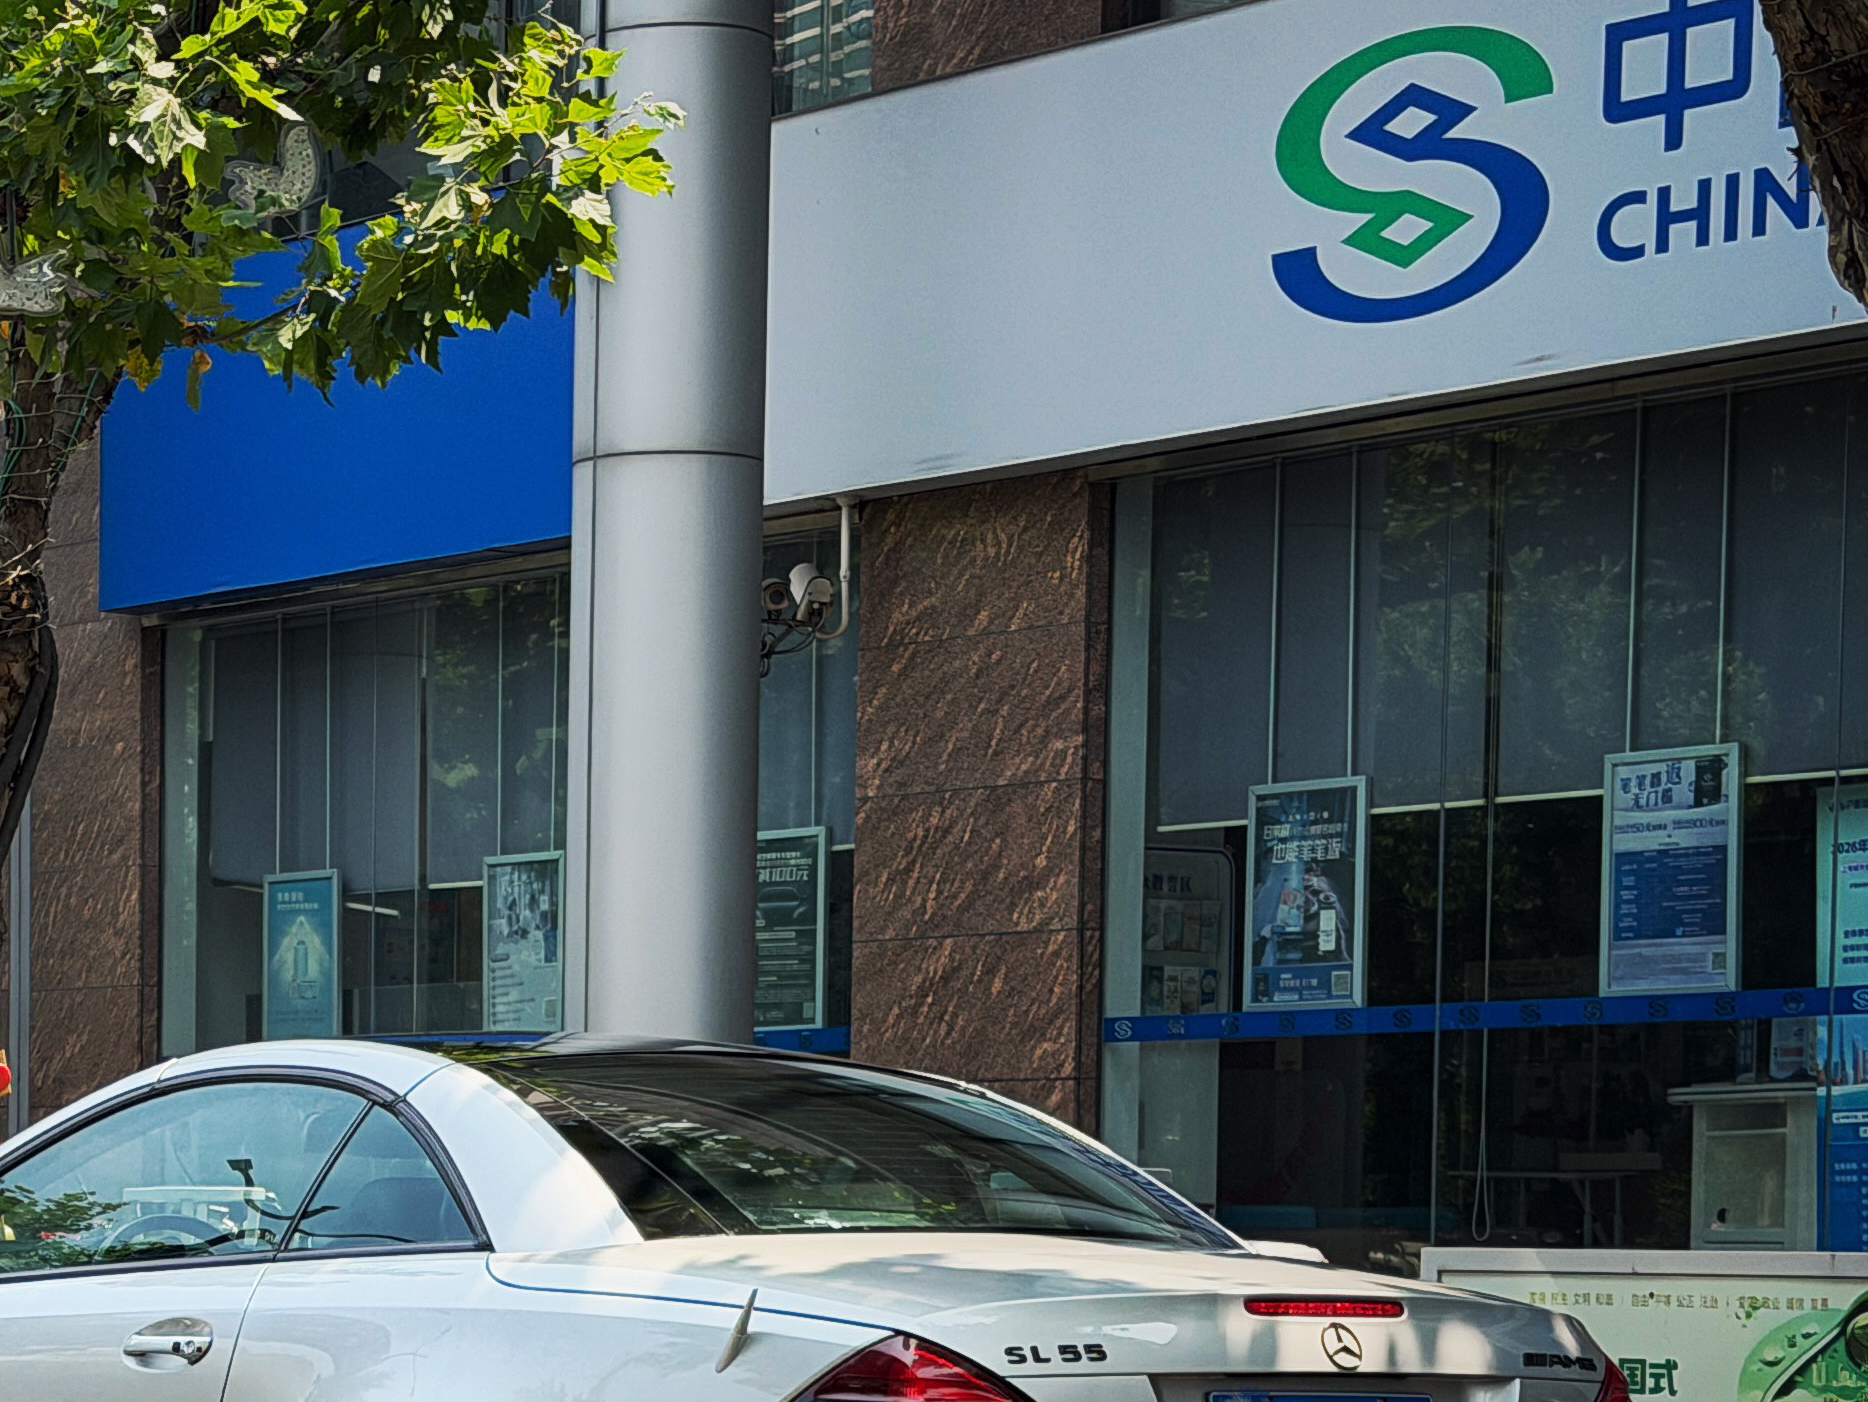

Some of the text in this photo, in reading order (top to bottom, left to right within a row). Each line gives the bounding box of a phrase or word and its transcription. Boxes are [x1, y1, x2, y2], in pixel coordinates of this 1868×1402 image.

[1596, 166, 1826, 262] CHIN
[1004, 1343, 1108, 1365] SL 55
